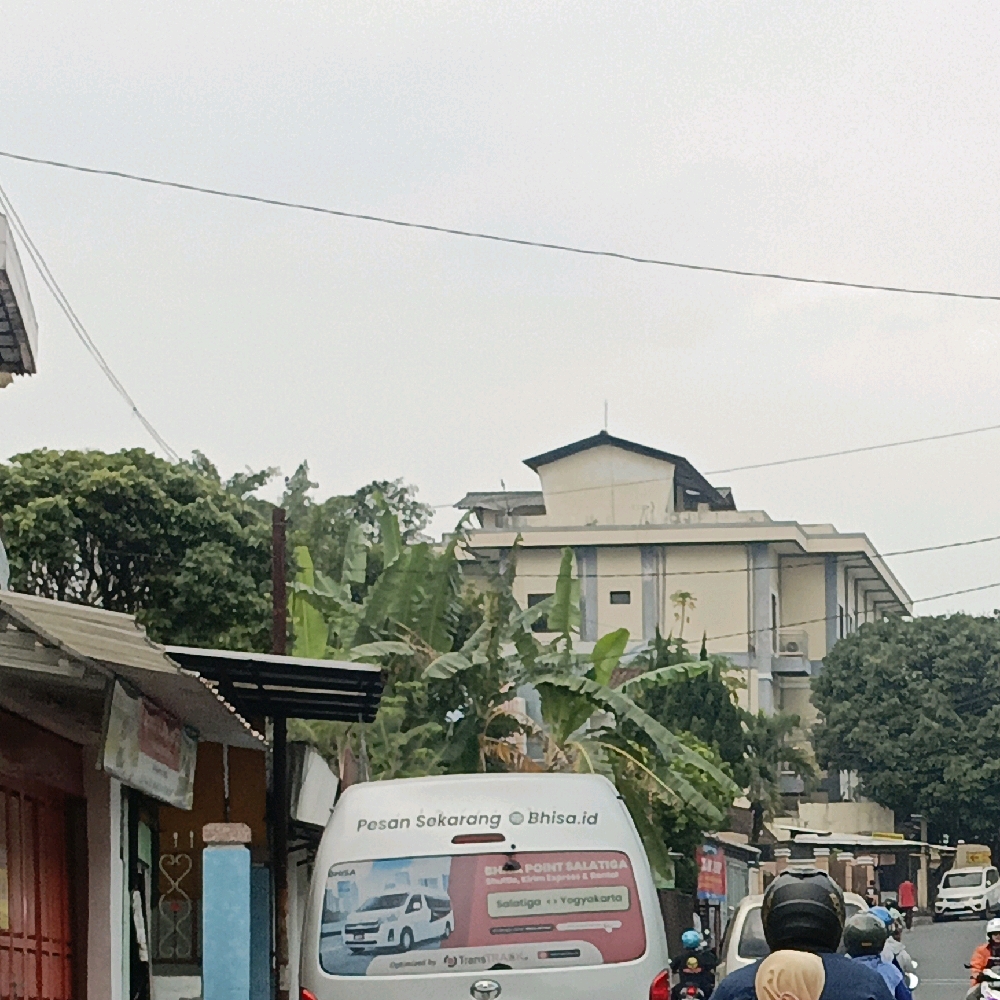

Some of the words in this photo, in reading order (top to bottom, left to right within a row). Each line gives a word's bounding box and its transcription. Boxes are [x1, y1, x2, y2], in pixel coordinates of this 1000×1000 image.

[356, 816, 411, 832] Pesan
[416, 813, 502, 829] Sekarang
[527, 811, 599, 826] Bhisa.id
[524, 861, 564, 874] POINT
[566, 859, 629, 871] SALATIGA
[496, 898, 541, 909] Salatiga
[560, 894, 623, 906] Yogyakarta
